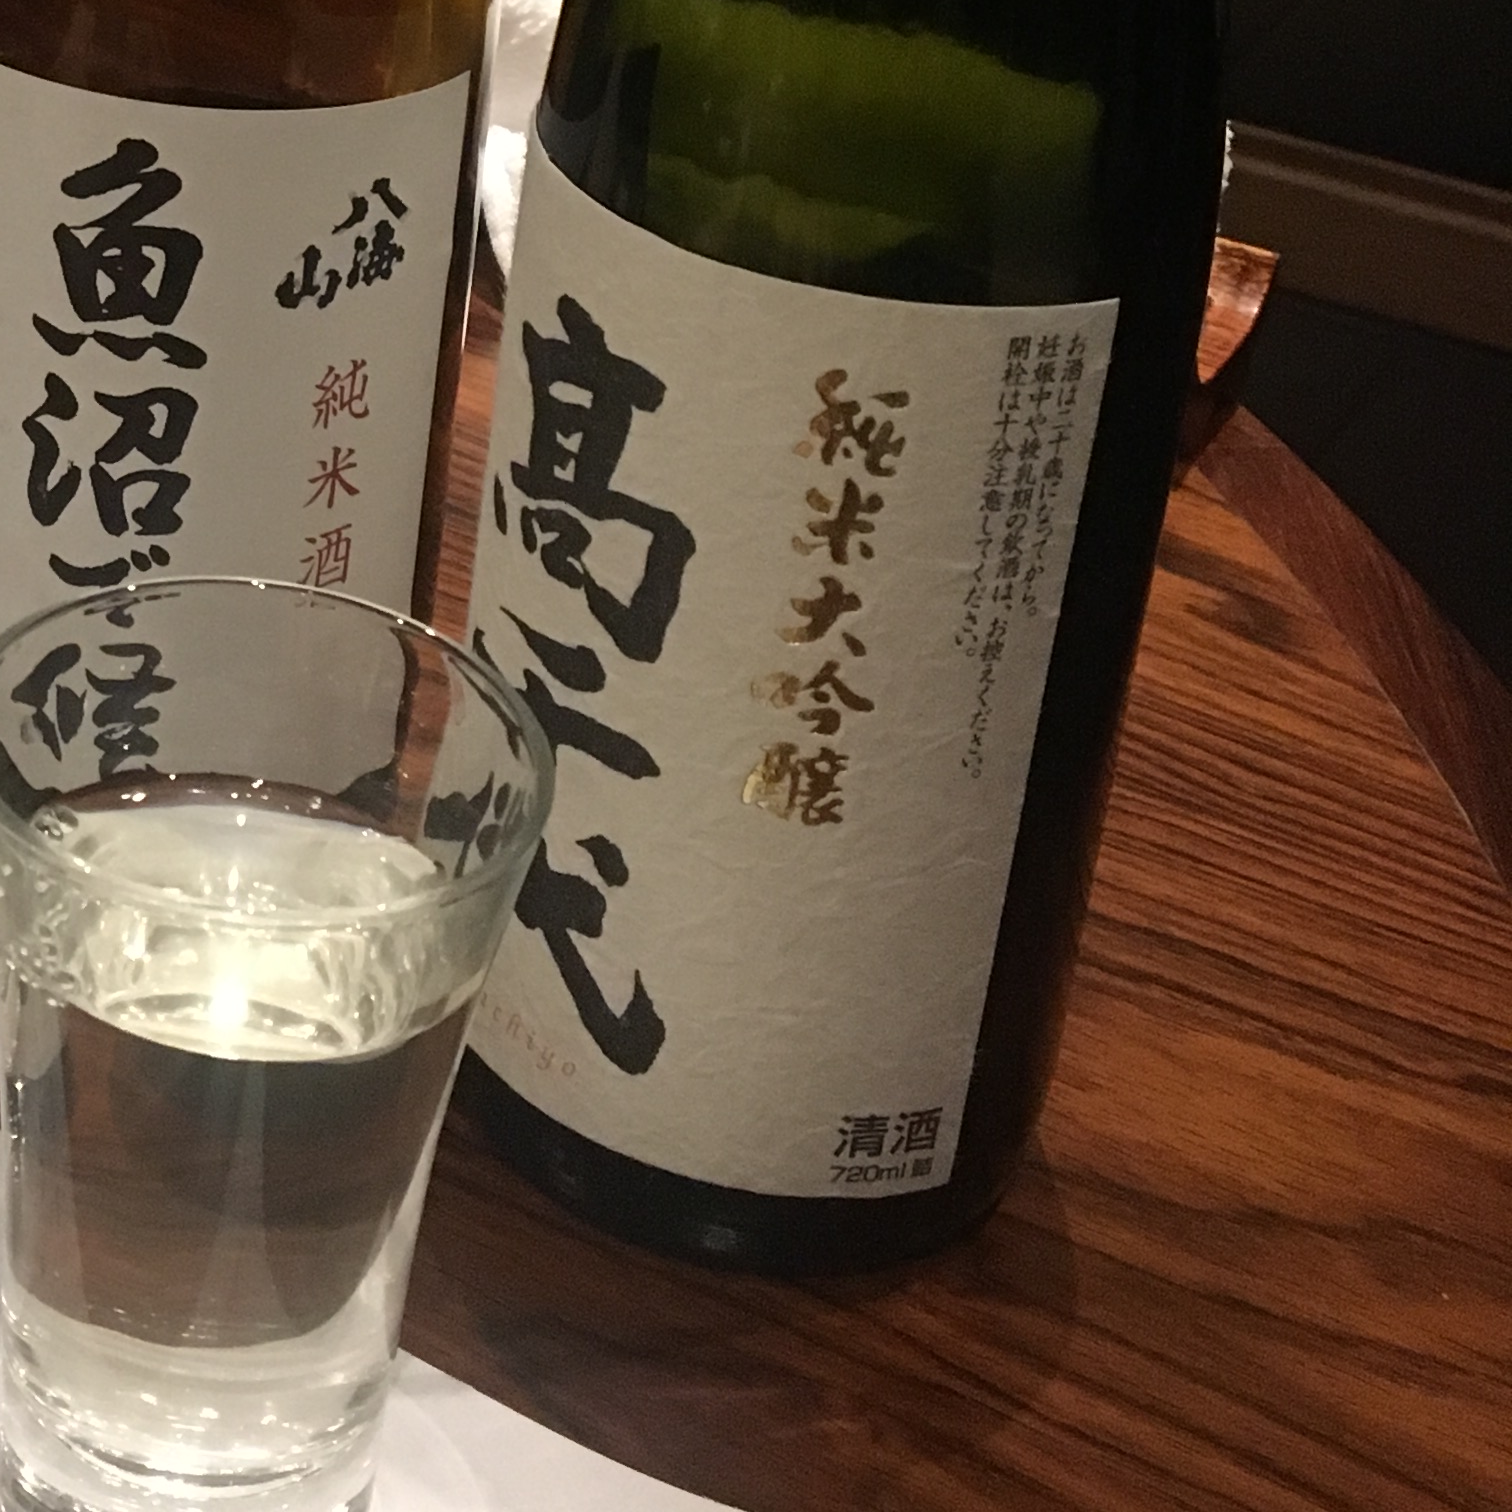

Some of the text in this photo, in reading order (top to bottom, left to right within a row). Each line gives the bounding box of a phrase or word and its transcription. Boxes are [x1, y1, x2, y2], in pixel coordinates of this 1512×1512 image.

[276, 176, 410, 310] 八海山
[296, 357, 372, 596] 純米酒
[833, 1107, 943, 1158] 清酒
